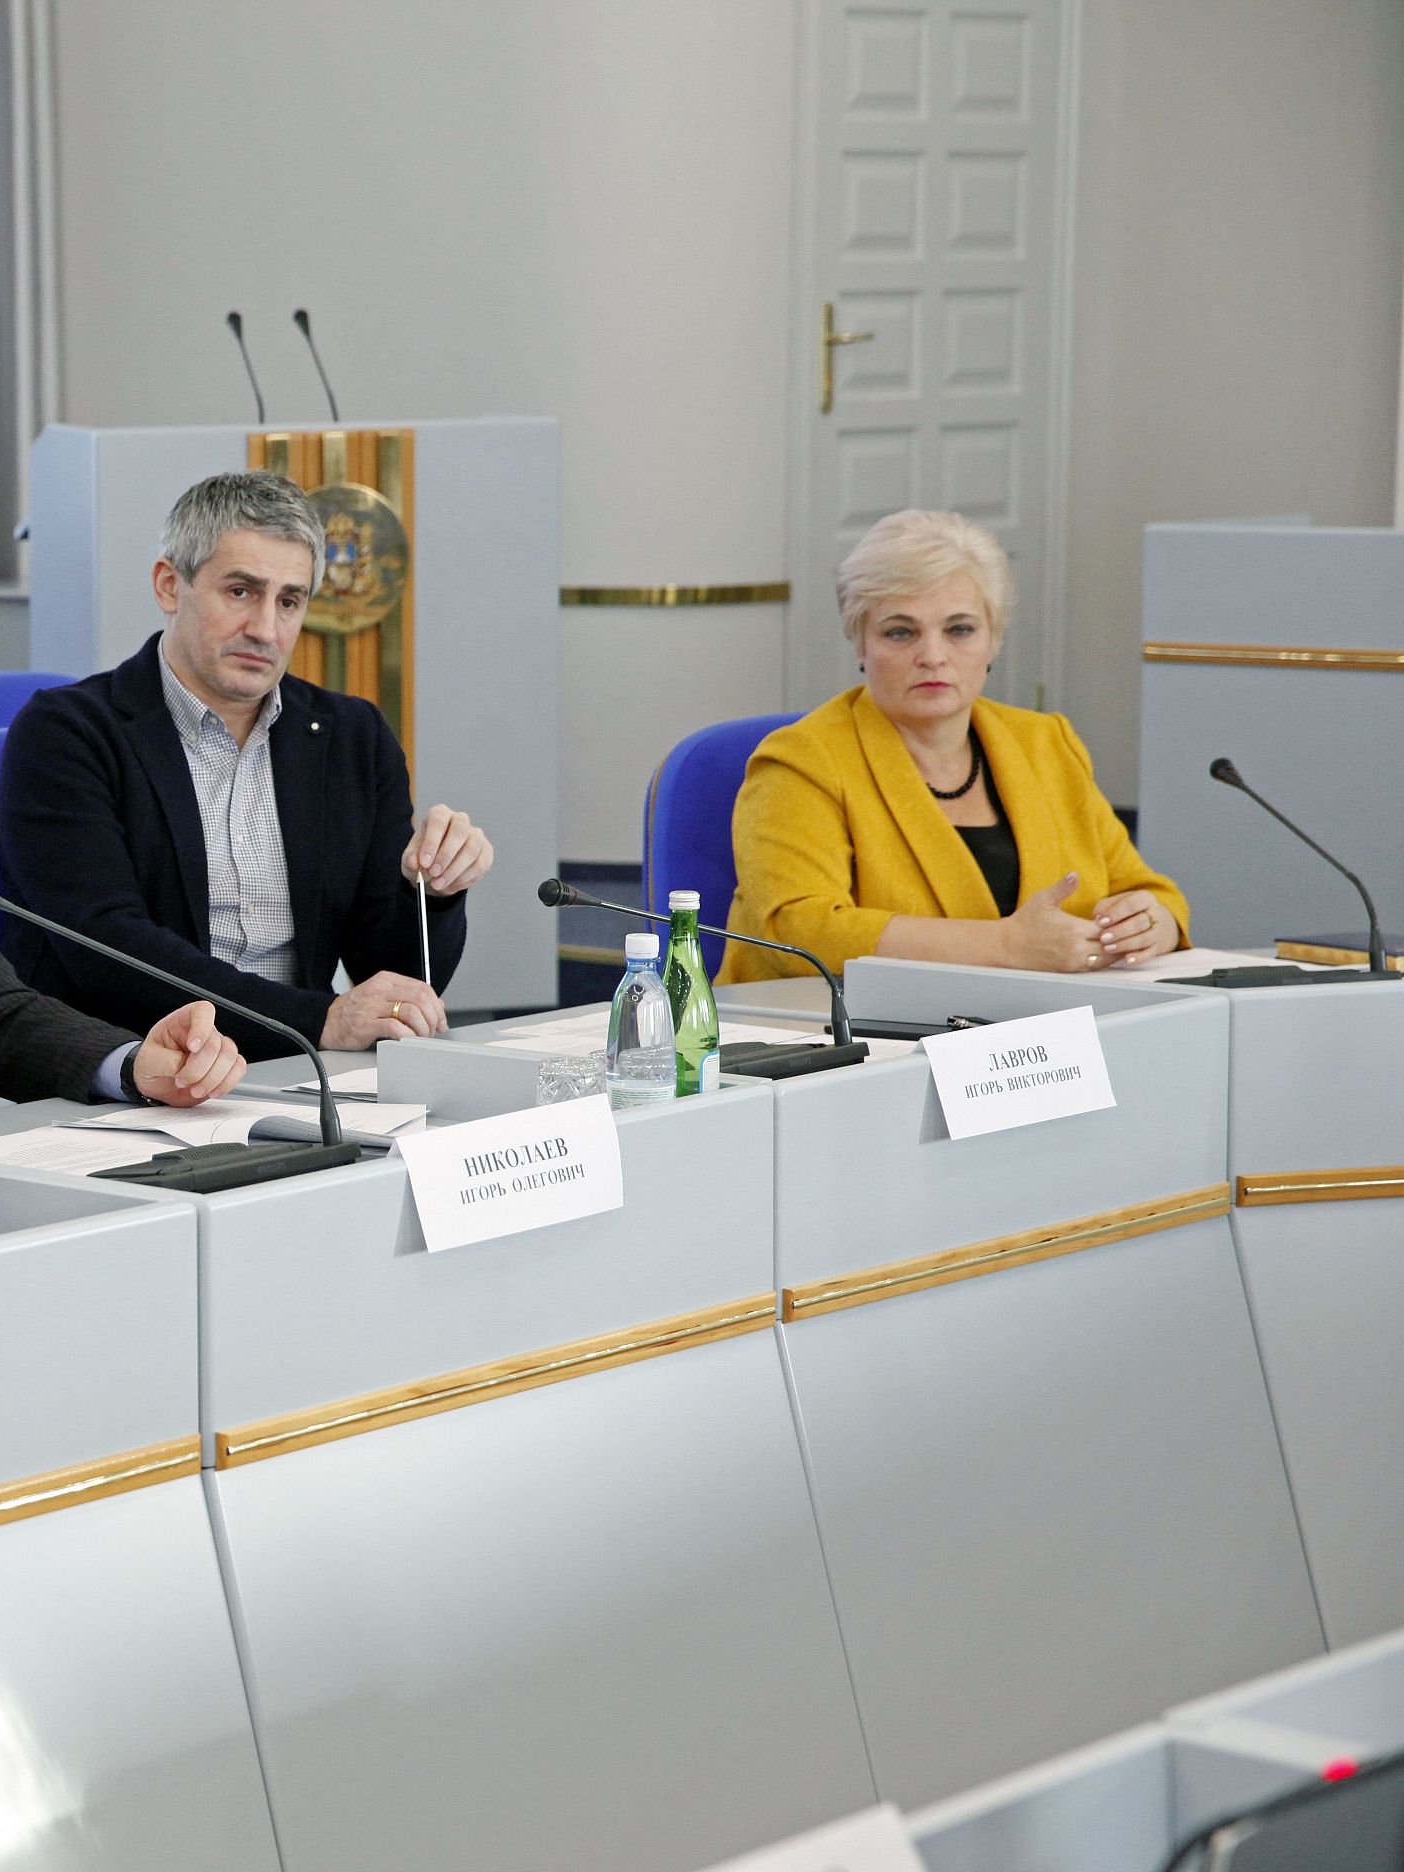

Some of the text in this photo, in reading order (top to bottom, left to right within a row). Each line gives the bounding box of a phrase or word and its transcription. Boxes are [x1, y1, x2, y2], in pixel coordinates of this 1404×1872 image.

[989, 1045, 1048, 1072] ЛАВРОВ
[964, 1066, 1082, 1099] ИГОРЬ ВИКТОРОВИЧ
[463, 1137, 568, 1177] НИКОЛАЕВ
[460, 1164, 585, 1205] ИГОРЬ ОЛЕГОВИЧ
